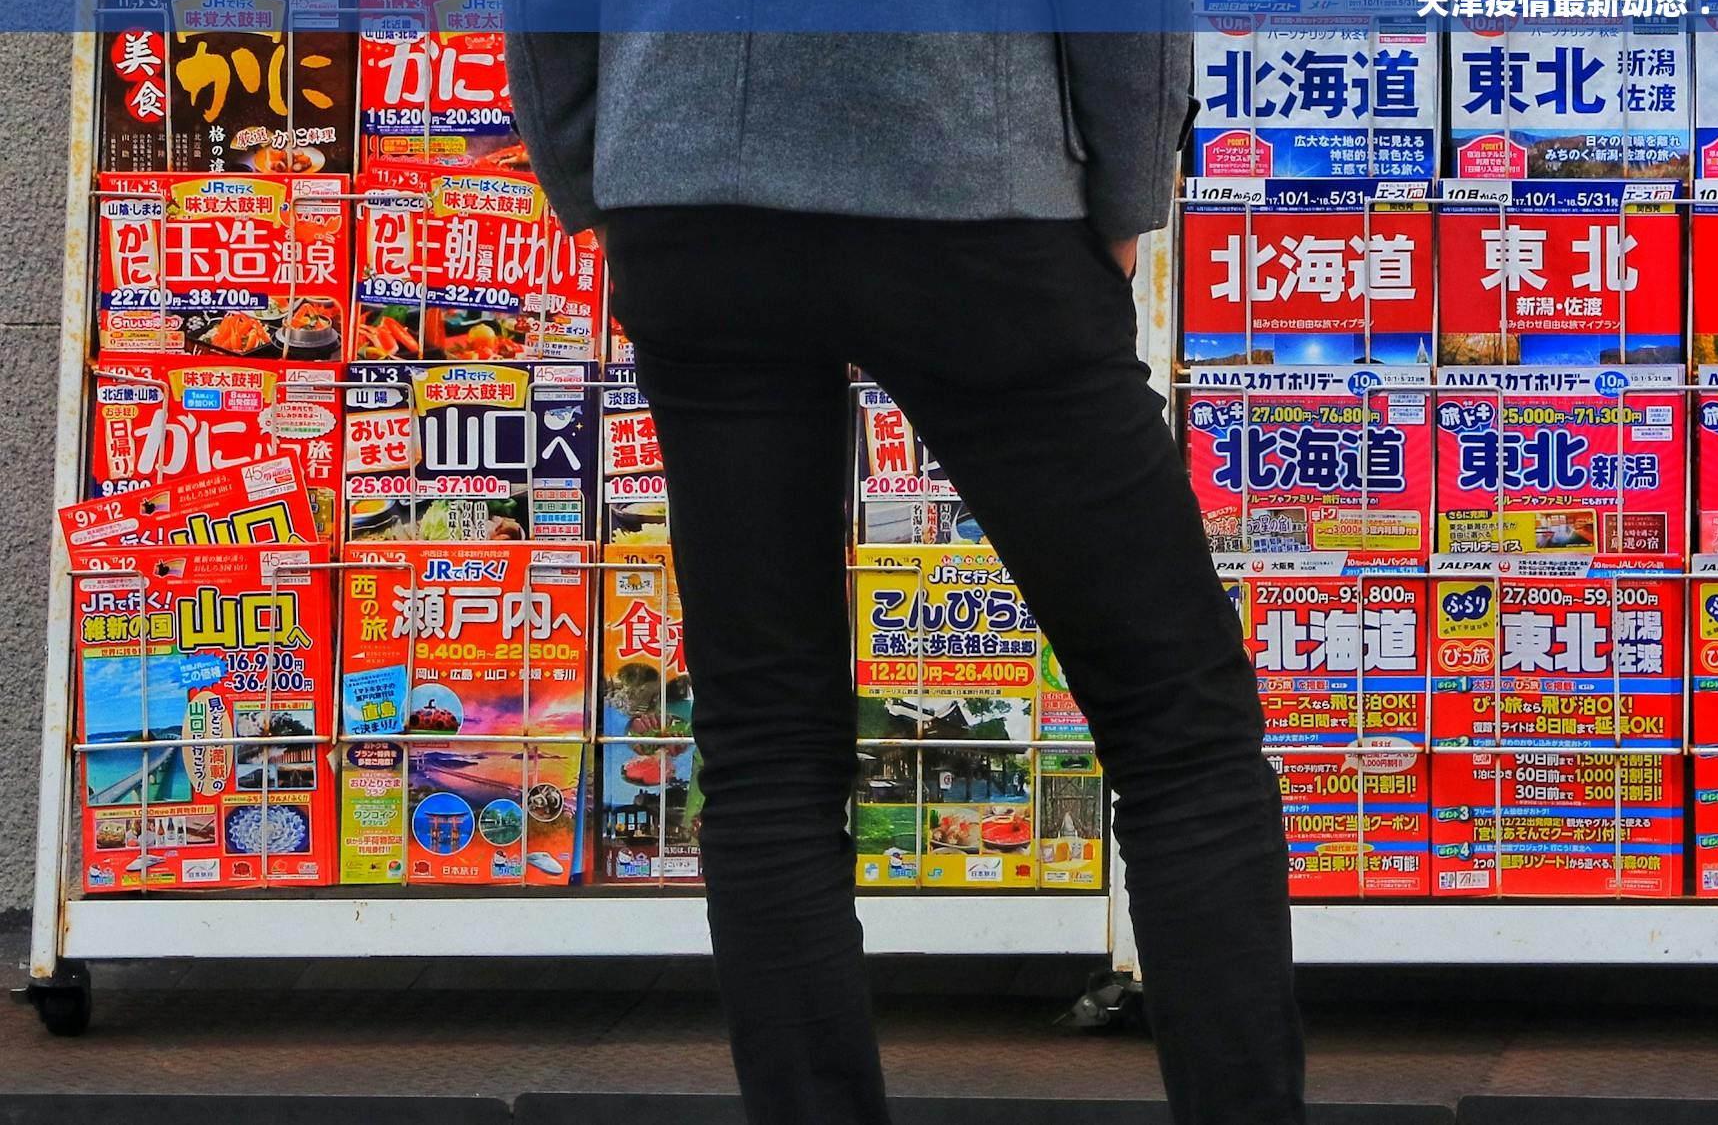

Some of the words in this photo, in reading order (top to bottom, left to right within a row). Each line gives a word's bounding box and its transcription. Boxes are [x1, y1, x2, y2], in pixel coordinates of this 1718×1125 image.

[1206, 49, 1421, 120] 北海道
[1462, 46, 1606, 117] 東北
[185, 196, 274, 214] 味覚太鼓判
[202, 179, 255, 194] JRで行く
[1210, 234, 1417, 303] 北海道
[1479, 225, 1639, 293] 東北
[1515, 296, 1603, 317] 新潟・佐渡
[425, 383, 516, 401] 味覚太鼓判
[441, 368, 496, 383] JRで行く
[1214, 427, 1406, 492] 北海道
[1459, 429, 1588, 491] 東北
[422, 559, 507, 582] JRで行く!
[1437, 561, 1492, 572] JALPAK
[178, 587, 312, 652] 山口へ
[392, 585, 583, 642] 瀬戸内へ
[1254, 609, 1419, 673] 北海道
